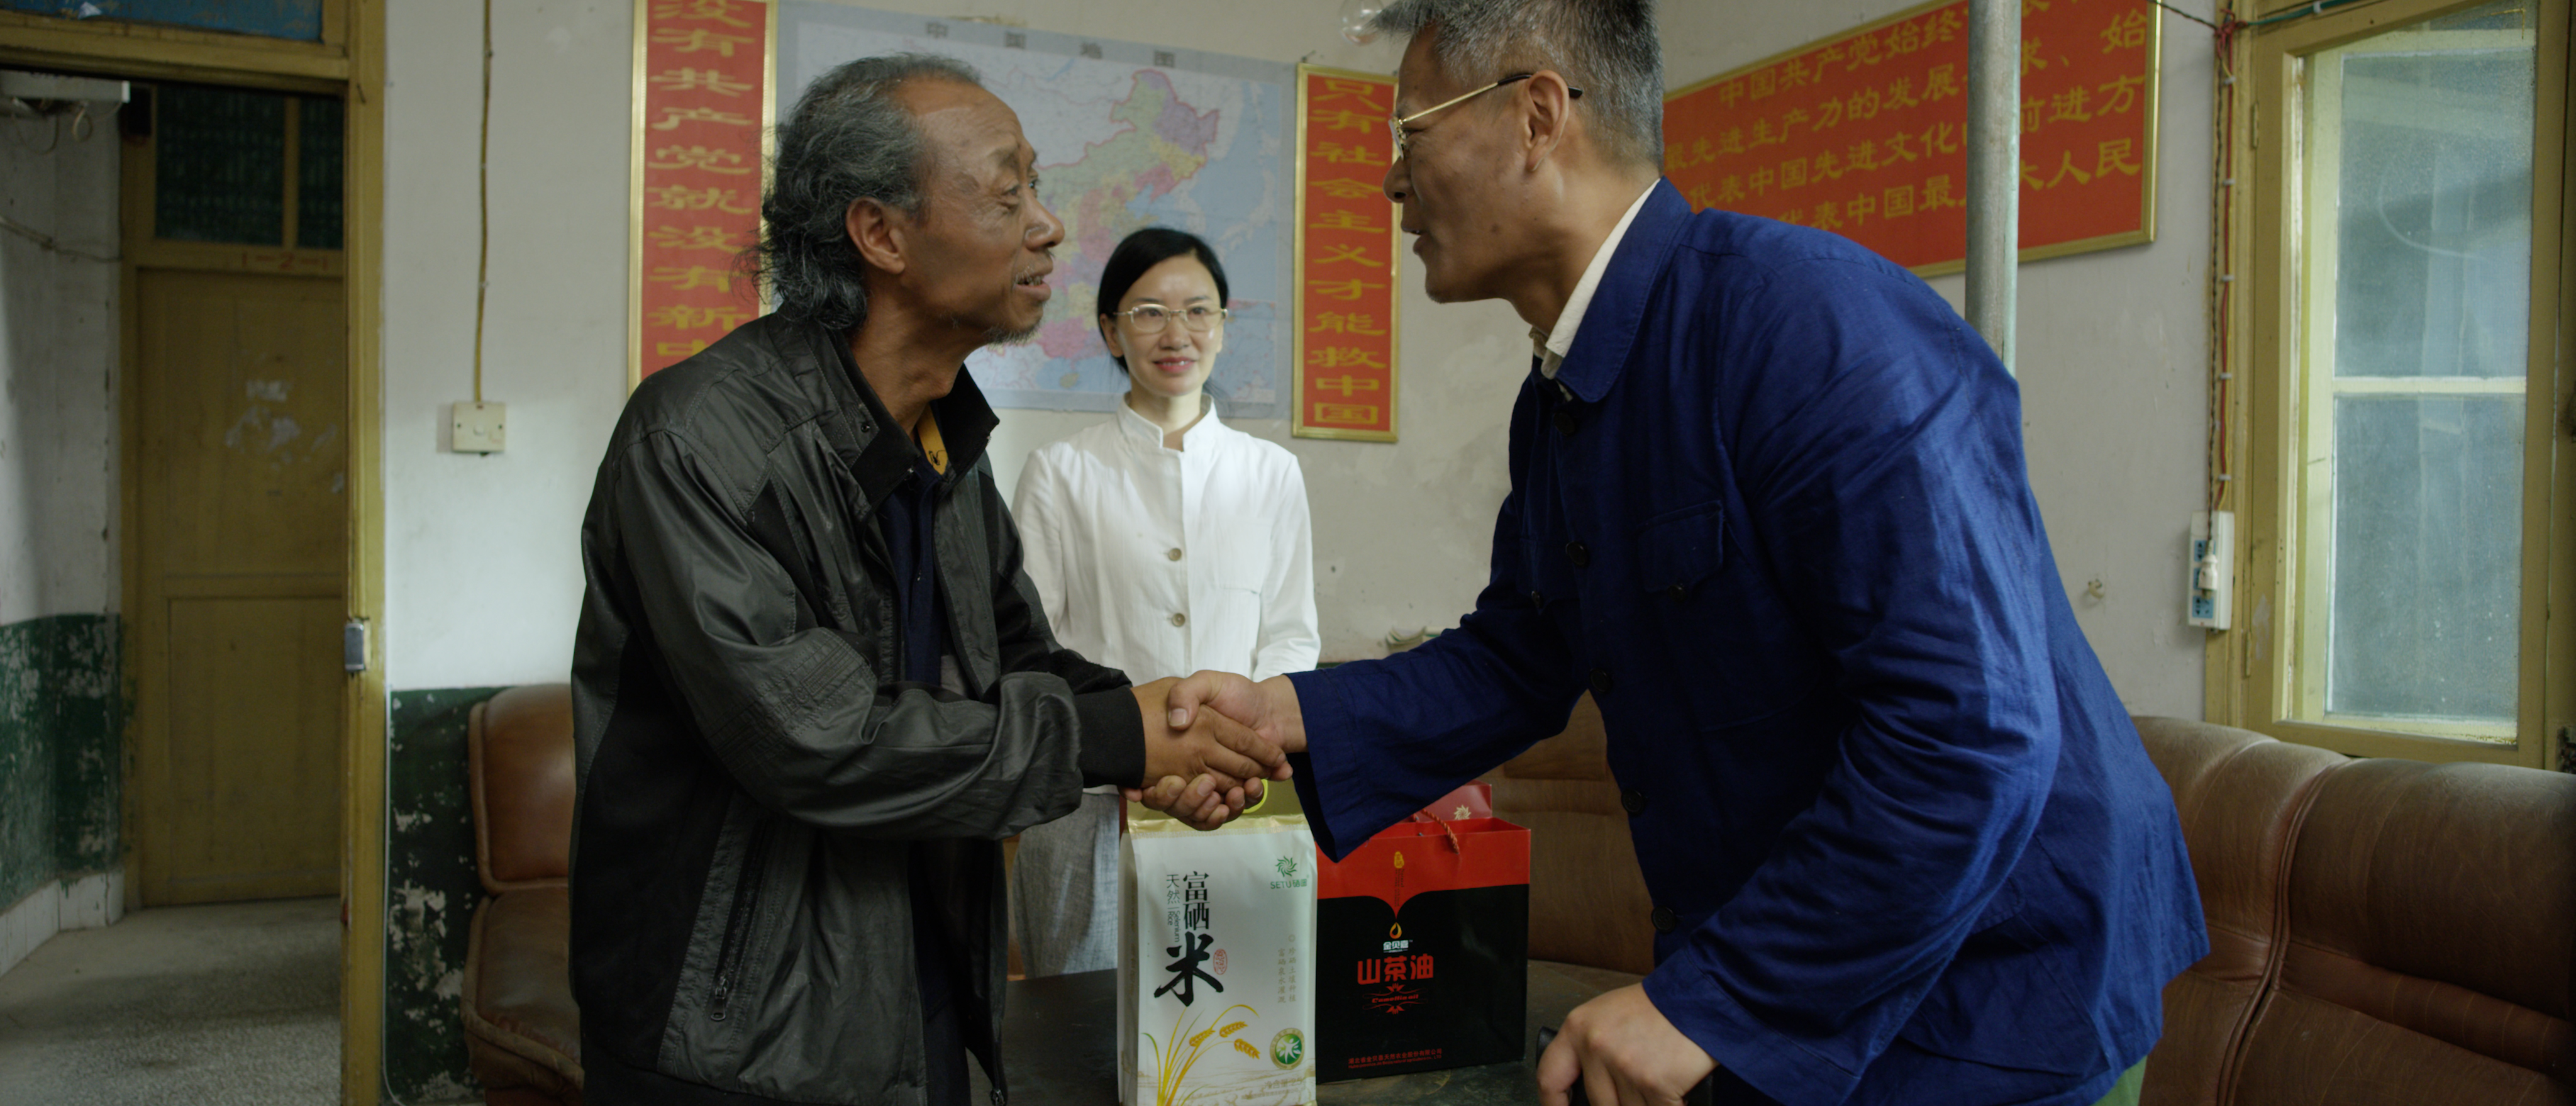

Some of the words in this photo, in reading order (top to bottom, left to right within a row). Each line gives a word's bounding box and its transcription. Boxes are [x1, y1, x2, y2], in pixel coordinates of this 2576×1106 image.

[1664, 8, 2147, 172] 最先进生产力的发展求、始
[1689, 74, 2146, 211] 代表中国先进文化前进方
[1307, 79, 1387, 425] 只有社会主义才能救中国
[1166, 874, 1180, 905] 天然
[1357, 953, 1434, 985] 山茶油
